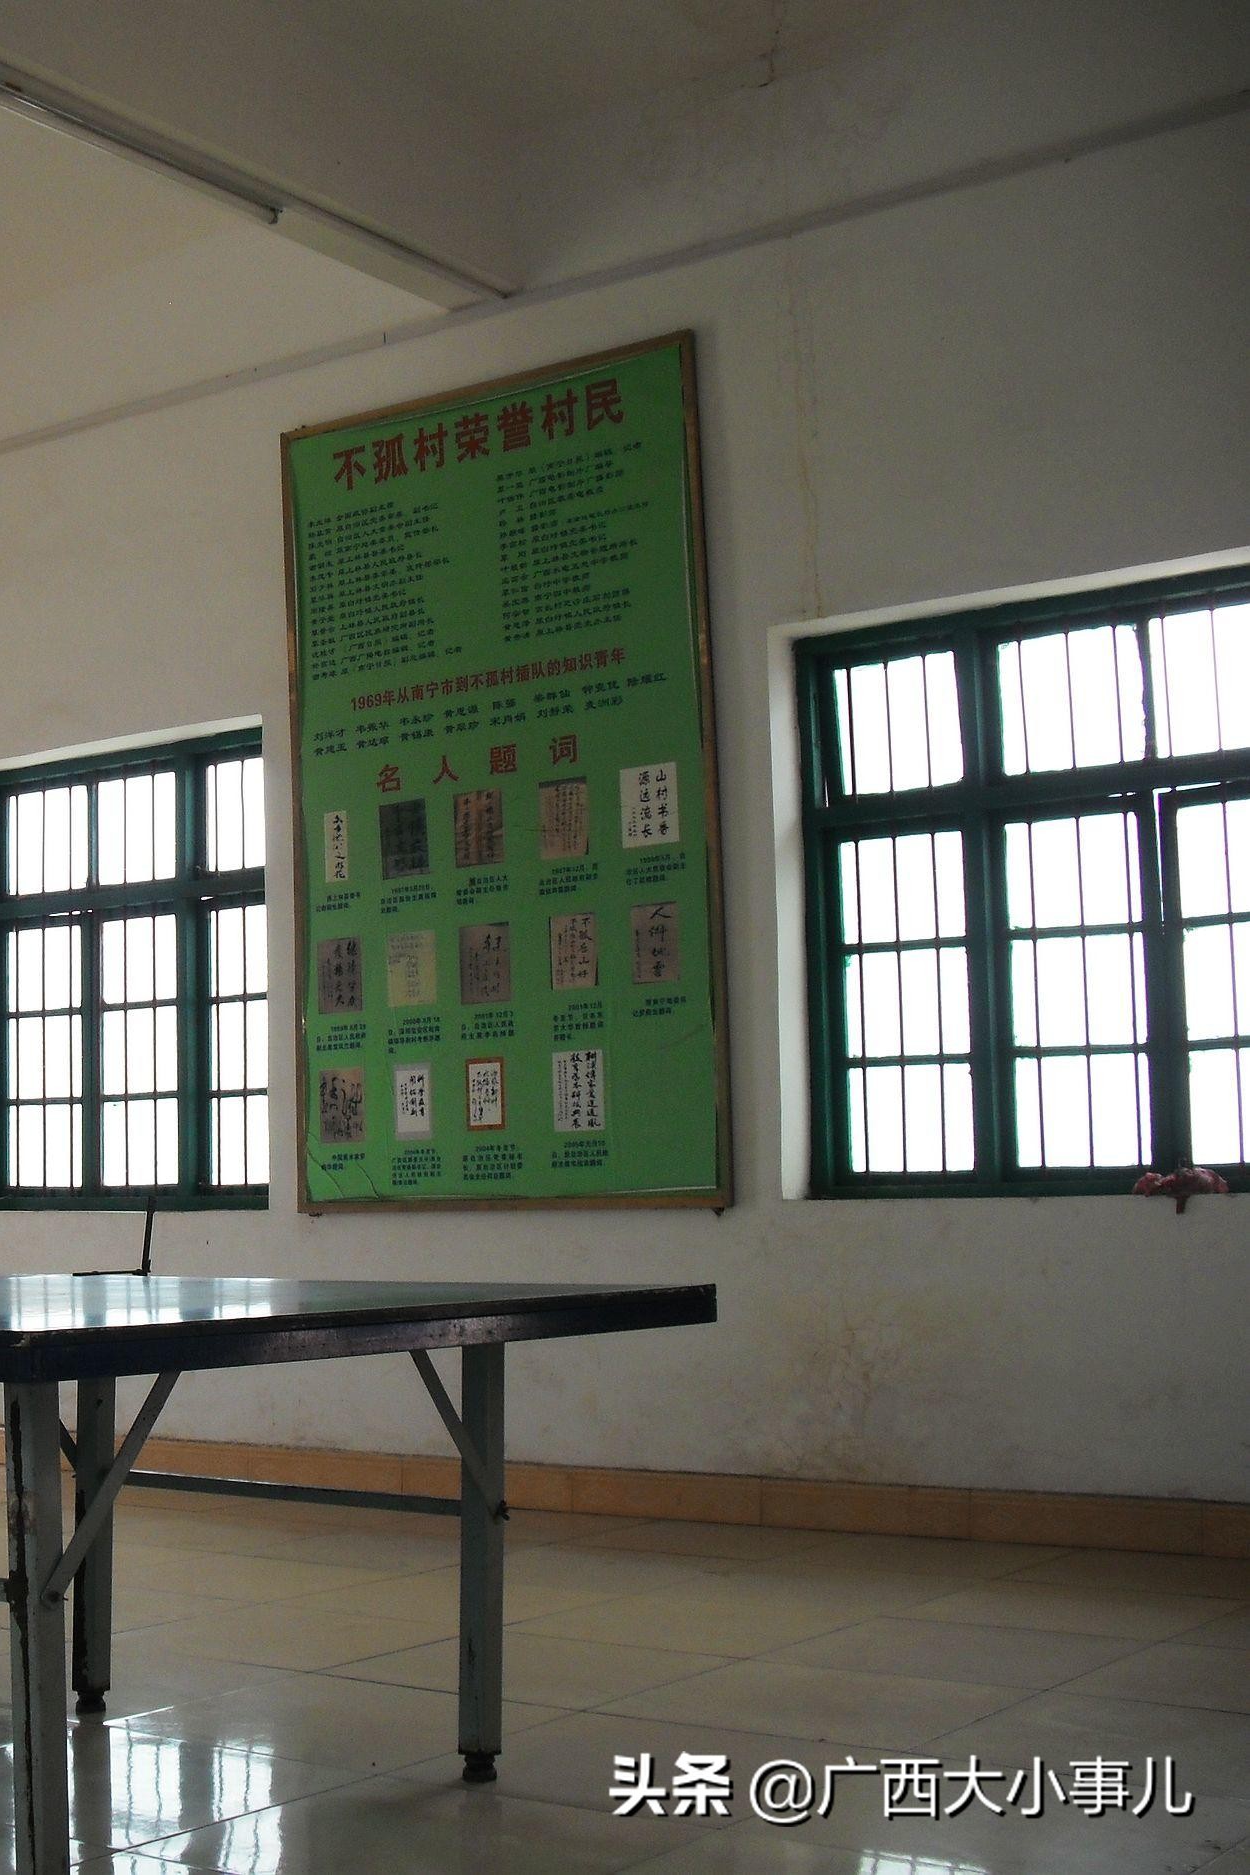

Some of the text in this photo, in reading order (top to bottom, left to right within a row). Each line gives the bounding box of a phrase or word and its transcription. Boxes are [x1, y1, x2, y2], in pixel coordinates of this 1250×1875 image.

[334, 378, 625, 492] 不孤村荣誉村民
[351, 647, 626, 711] 1969年从南宁市到不孤村插队的知识青年
[377, 734, 578, 793] 名人题词
